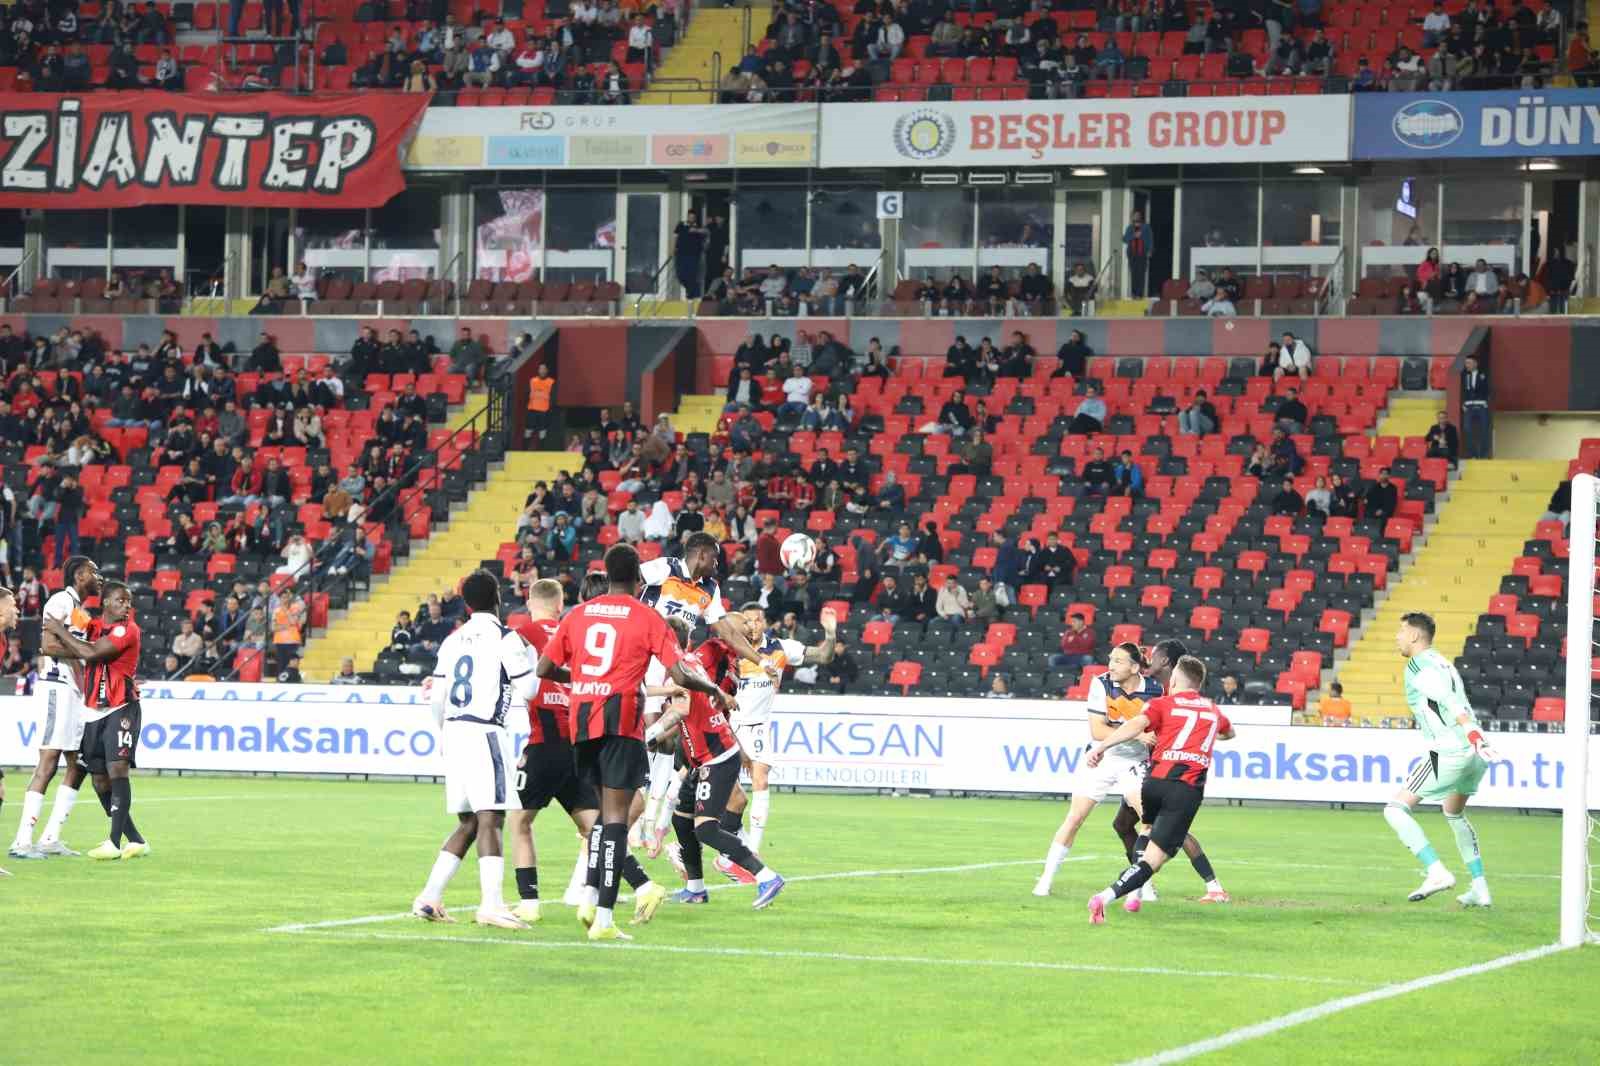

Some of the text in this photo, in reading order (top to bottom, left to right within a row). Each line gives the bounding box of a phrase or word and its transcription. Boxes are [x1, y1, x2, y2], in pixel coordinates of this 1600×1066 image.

[2, 99, 374, 189] ZİANTEP
[969, 109, 1286, 159] BEŞLER GROUP
[882, 196, 898, 215] G
[581, 622, 617, 676] 9
[449, 655, 473, 708] 8
[117, 731, 133, 748] 14
[1170, 708, 1217, 753] 77
